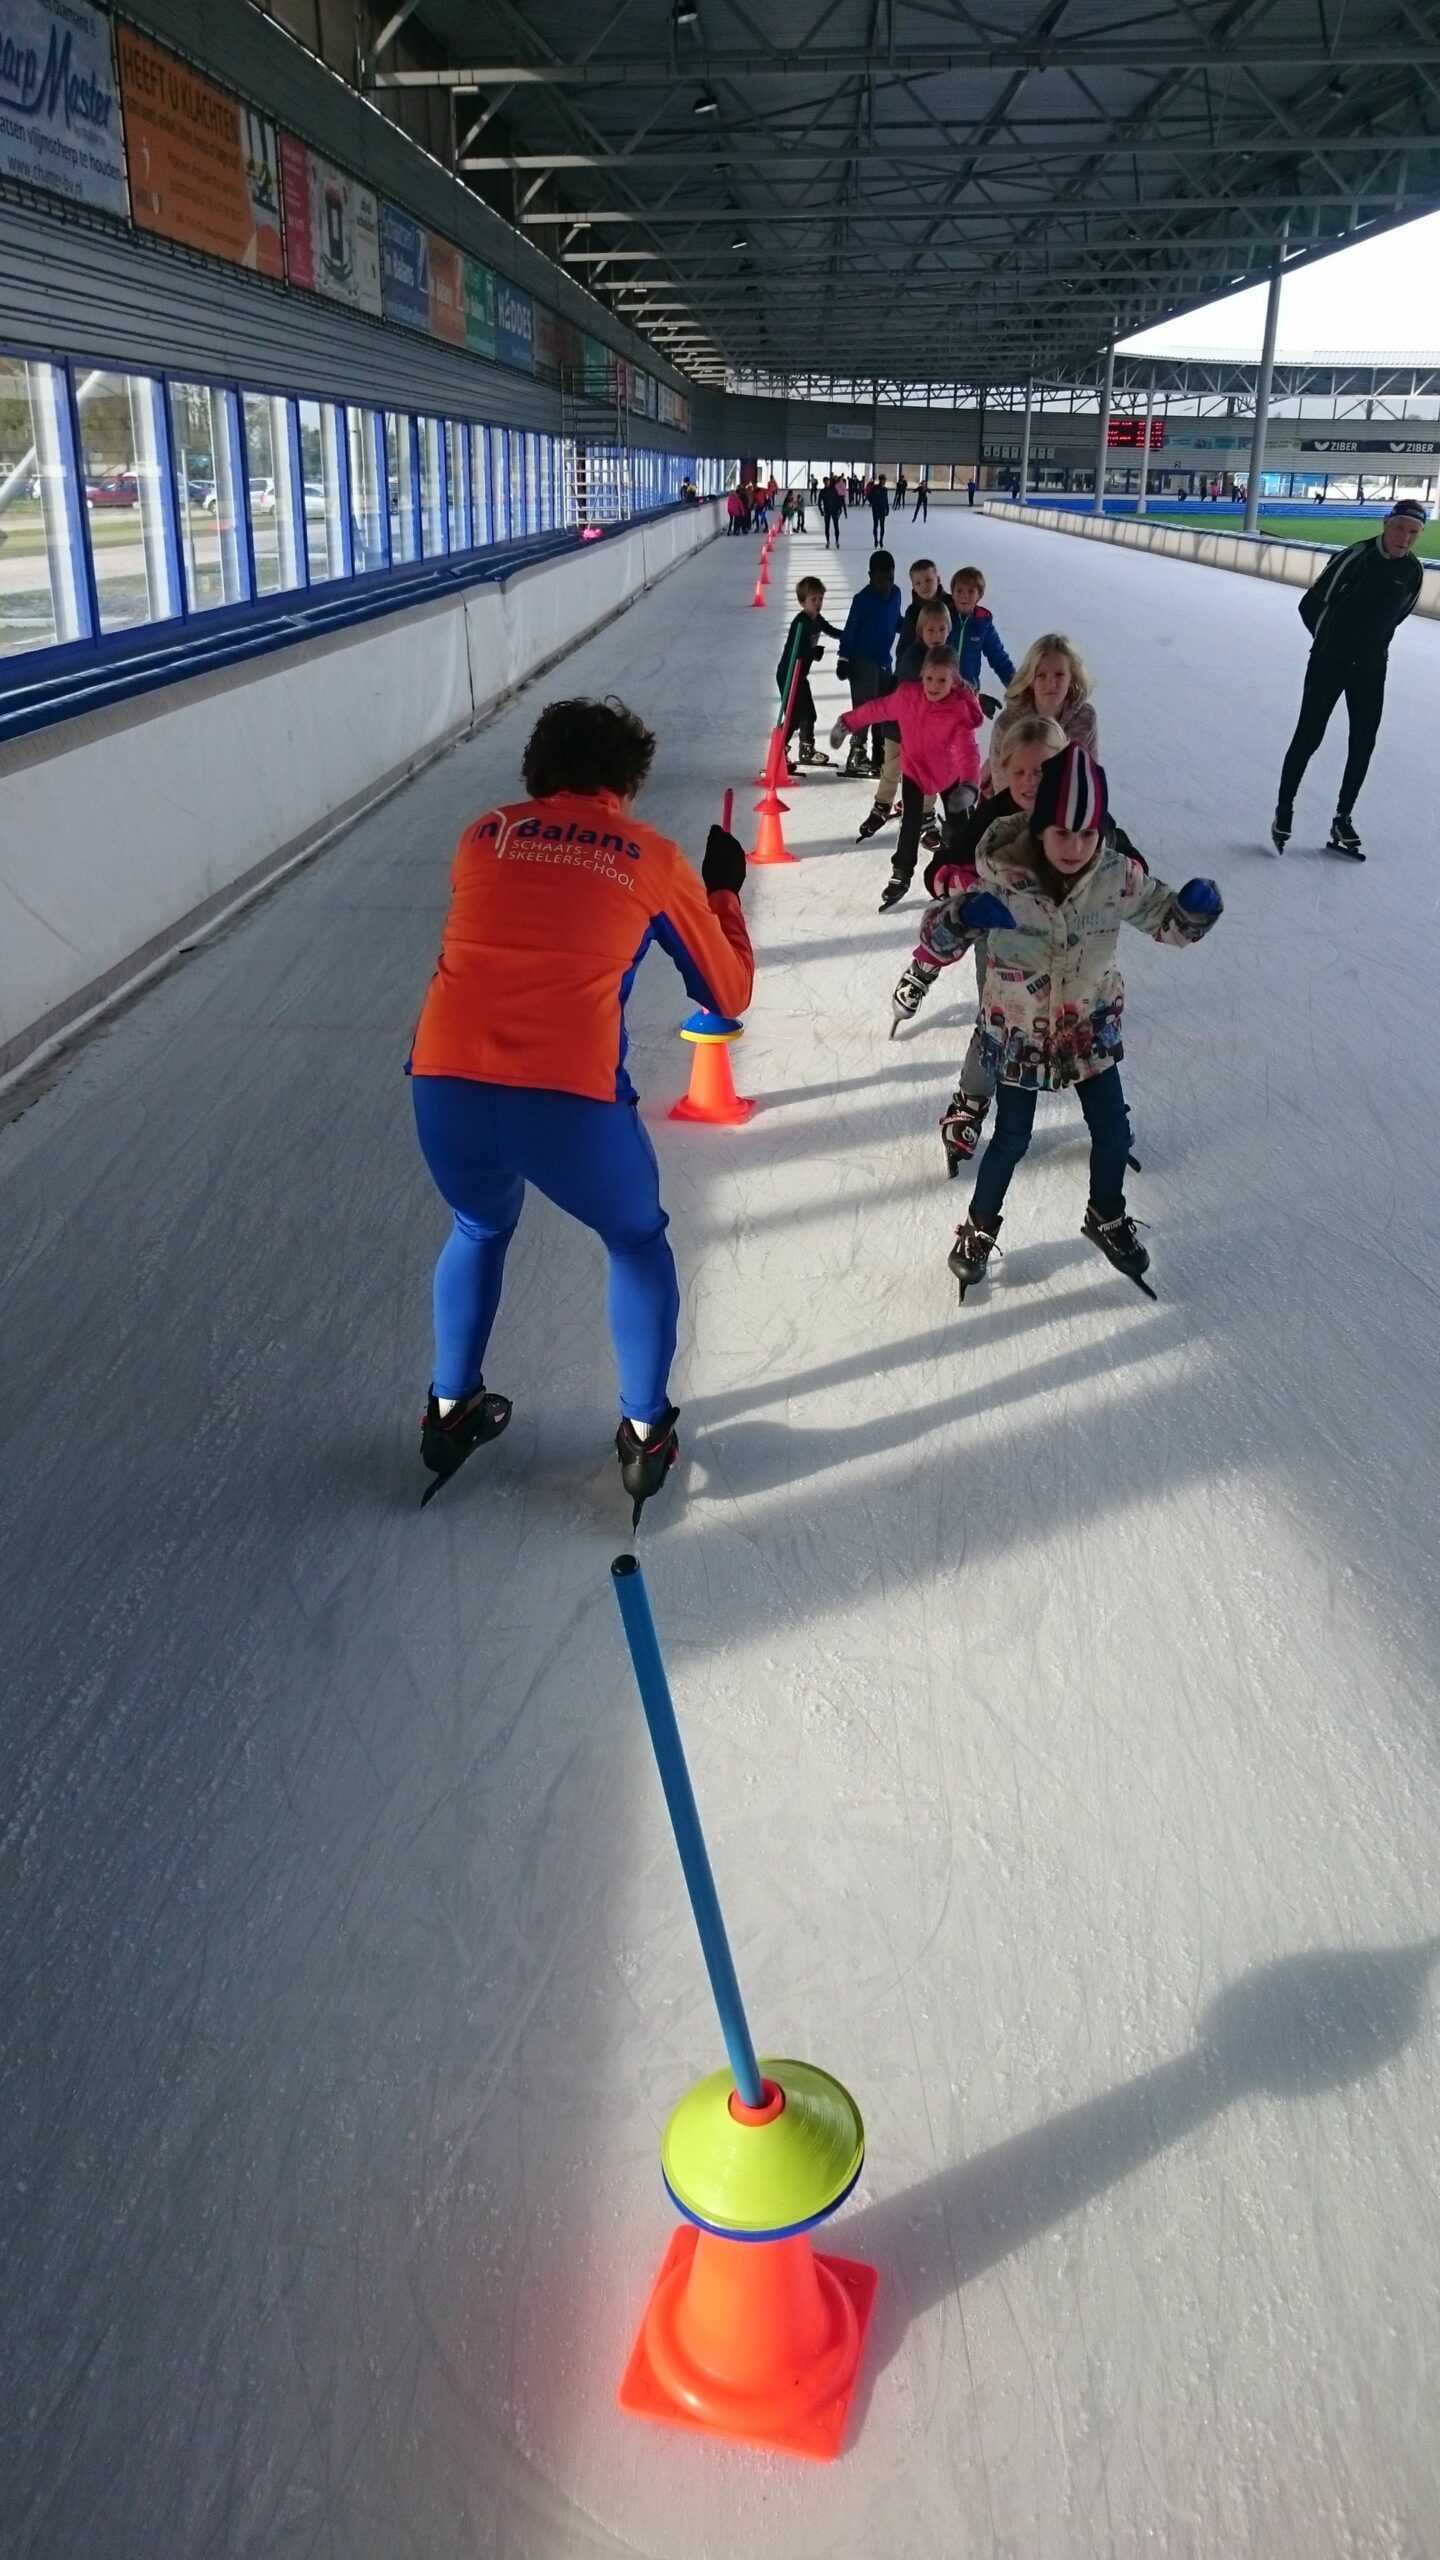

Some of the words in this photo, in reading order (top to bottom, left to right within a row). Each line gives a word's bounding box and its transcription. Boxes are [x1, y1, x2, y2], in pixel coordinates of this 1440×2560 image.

[0, 31, 38, 104] arp
[36, 24, 112, 131] Master
[122, 43, 166, 104] HEEFT
[168, 71, 178, 110] U
[79, 150, 88, 168] te
[89, 152, 121, 178] houden
[1330, 441, 1358, 452] ZIBER
[1406, 443, 1434, 453] ZIBER
[511, 839, 588, 855] SCHAATS-
[593, 849, 616, 865] EN
[516, 817, 642, 860] Balans
[508, 850, 636, 892] SKEELERSCHOOL
